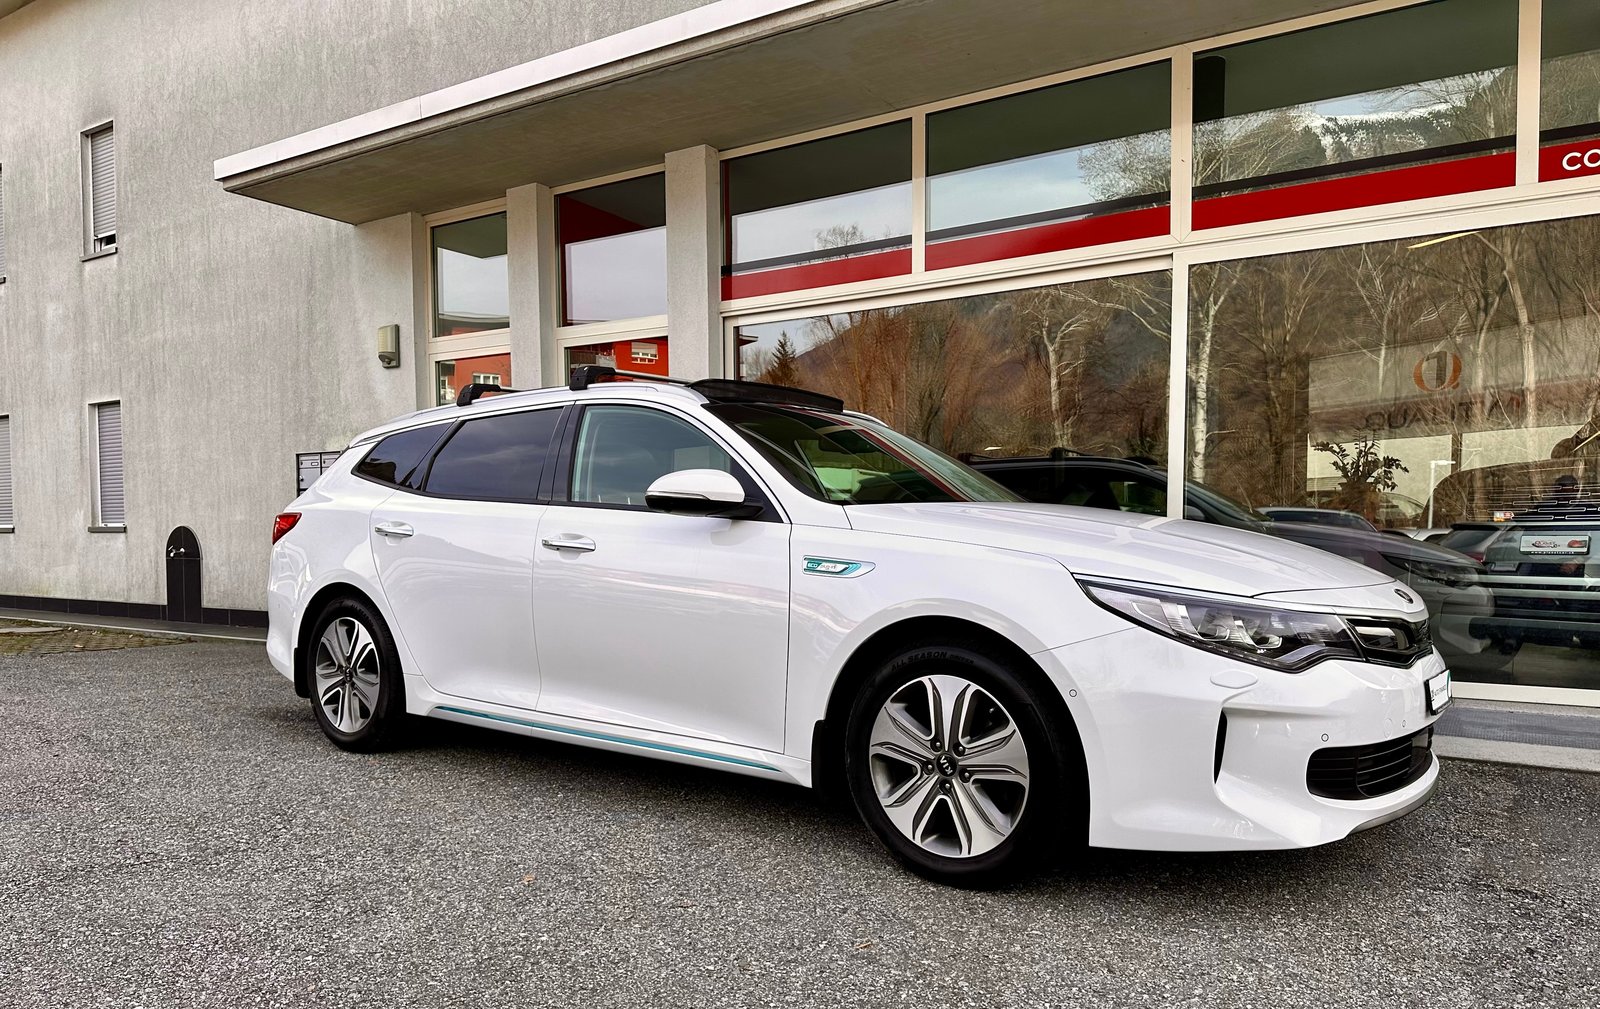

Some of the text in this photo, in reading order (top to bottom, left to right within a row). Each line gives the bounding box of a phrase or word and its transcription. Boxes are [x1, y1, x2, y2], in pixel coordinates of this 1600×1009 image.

[891, 659, 908, 672] ALL
[907, 651, 948, 664] SEASON
[940, 755, 954, 775] KIA
